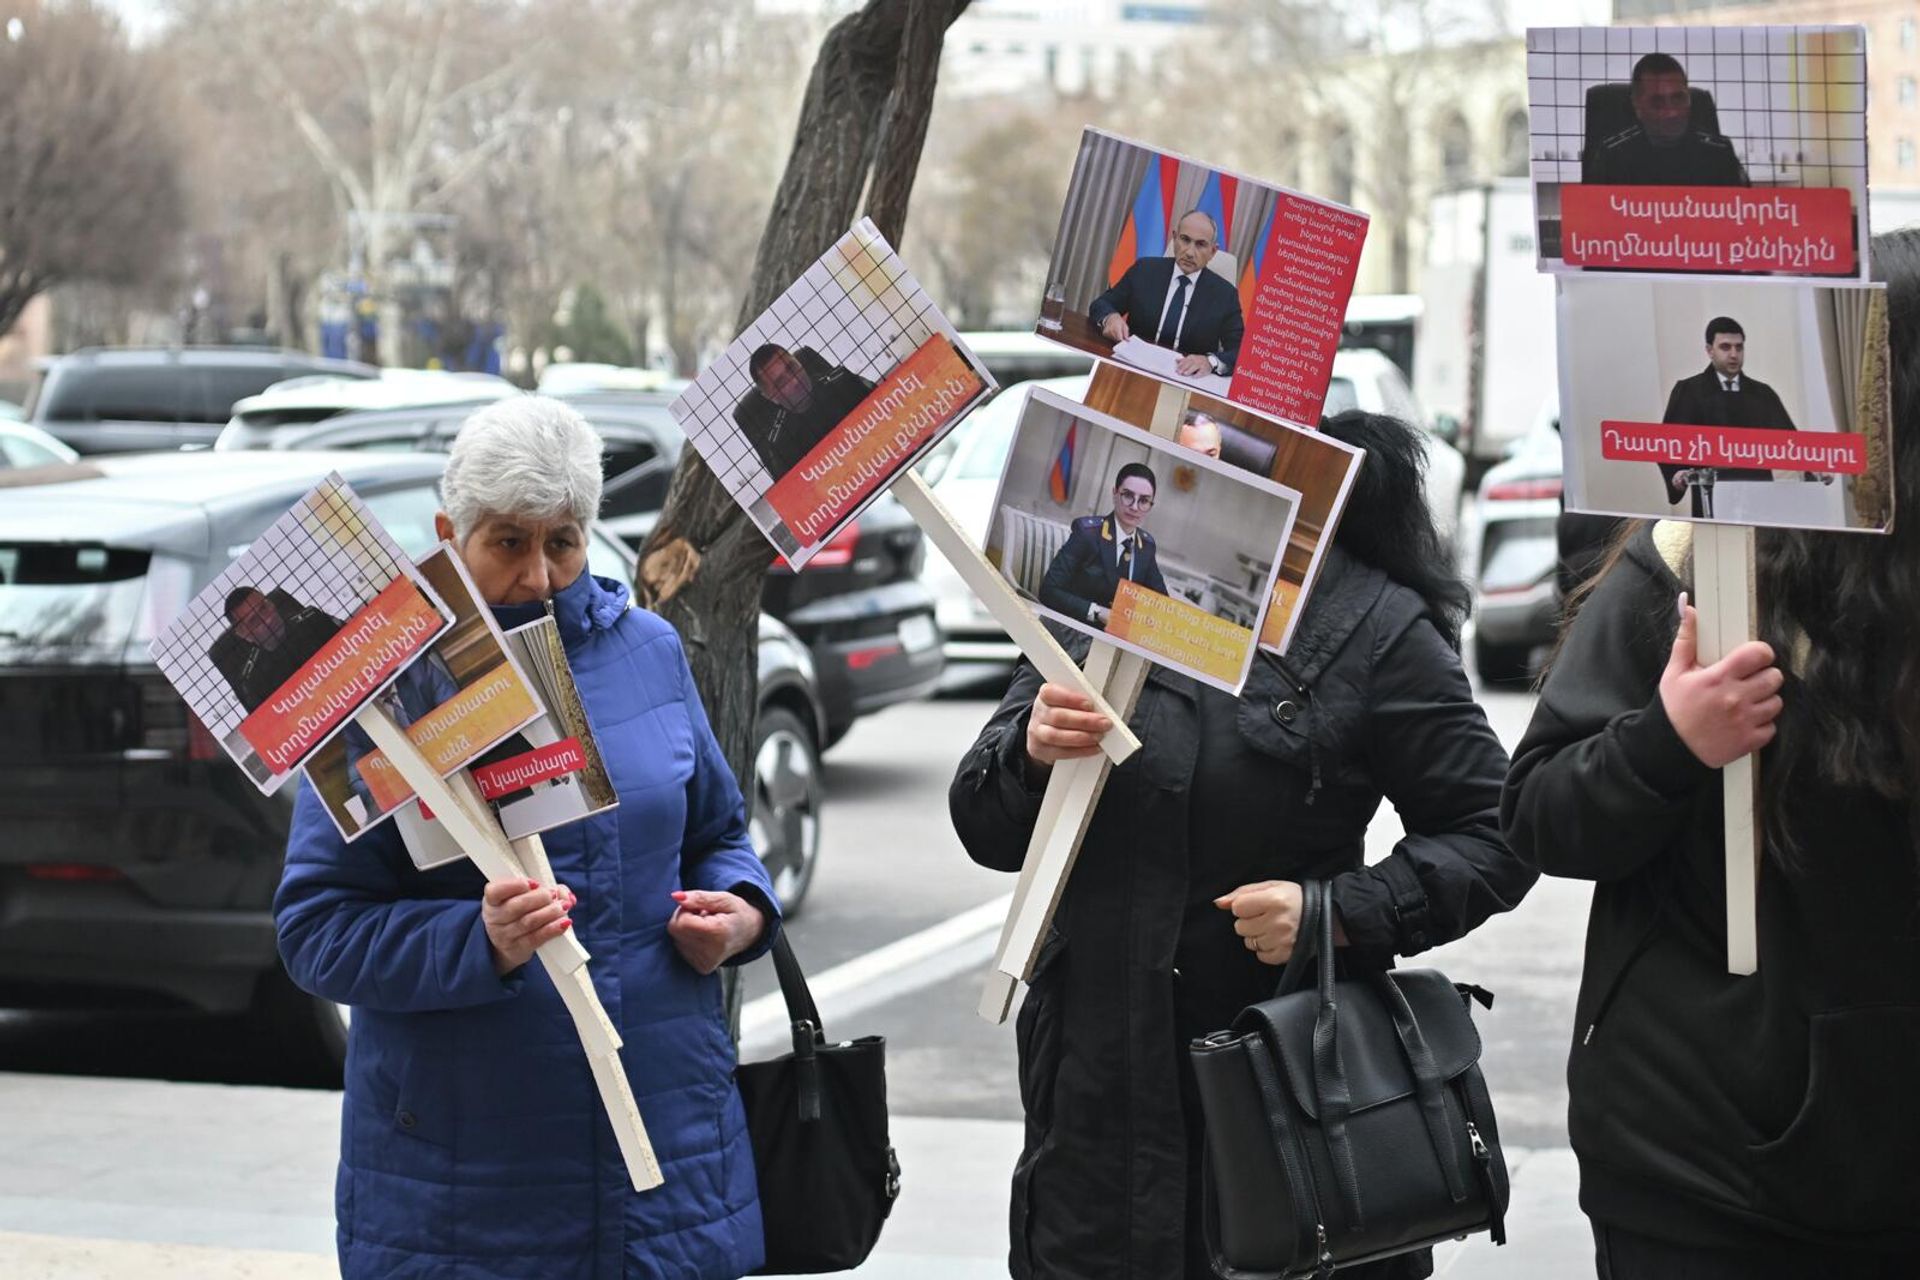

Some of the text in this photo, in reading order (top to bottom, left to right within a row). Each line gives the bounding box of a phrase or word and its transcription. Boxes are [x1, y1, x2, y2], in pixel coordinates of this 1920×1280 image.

[1610, 194, 1800, 226] Կալանավորել
[1571, 232, 1724, 265] կողմնակալ
[1729, 234, 1835, 267] քննիչին
[796, 380, 963, 535] կողմնակալ քննիչին
[801, 373, 922, 481] Կալանավորել
[1605, 430, 1858, 468] Դատը չի կայանալու
[267, 617, 426, 763] կողմնակալ քննիչին
[273, 614, 391, 713] Կալանավորել
[371, 680, 509, 768] Պասխանատու
[438, 734, 471, 763] անձ
[477, 750, 578, 798] ի կայանալու
